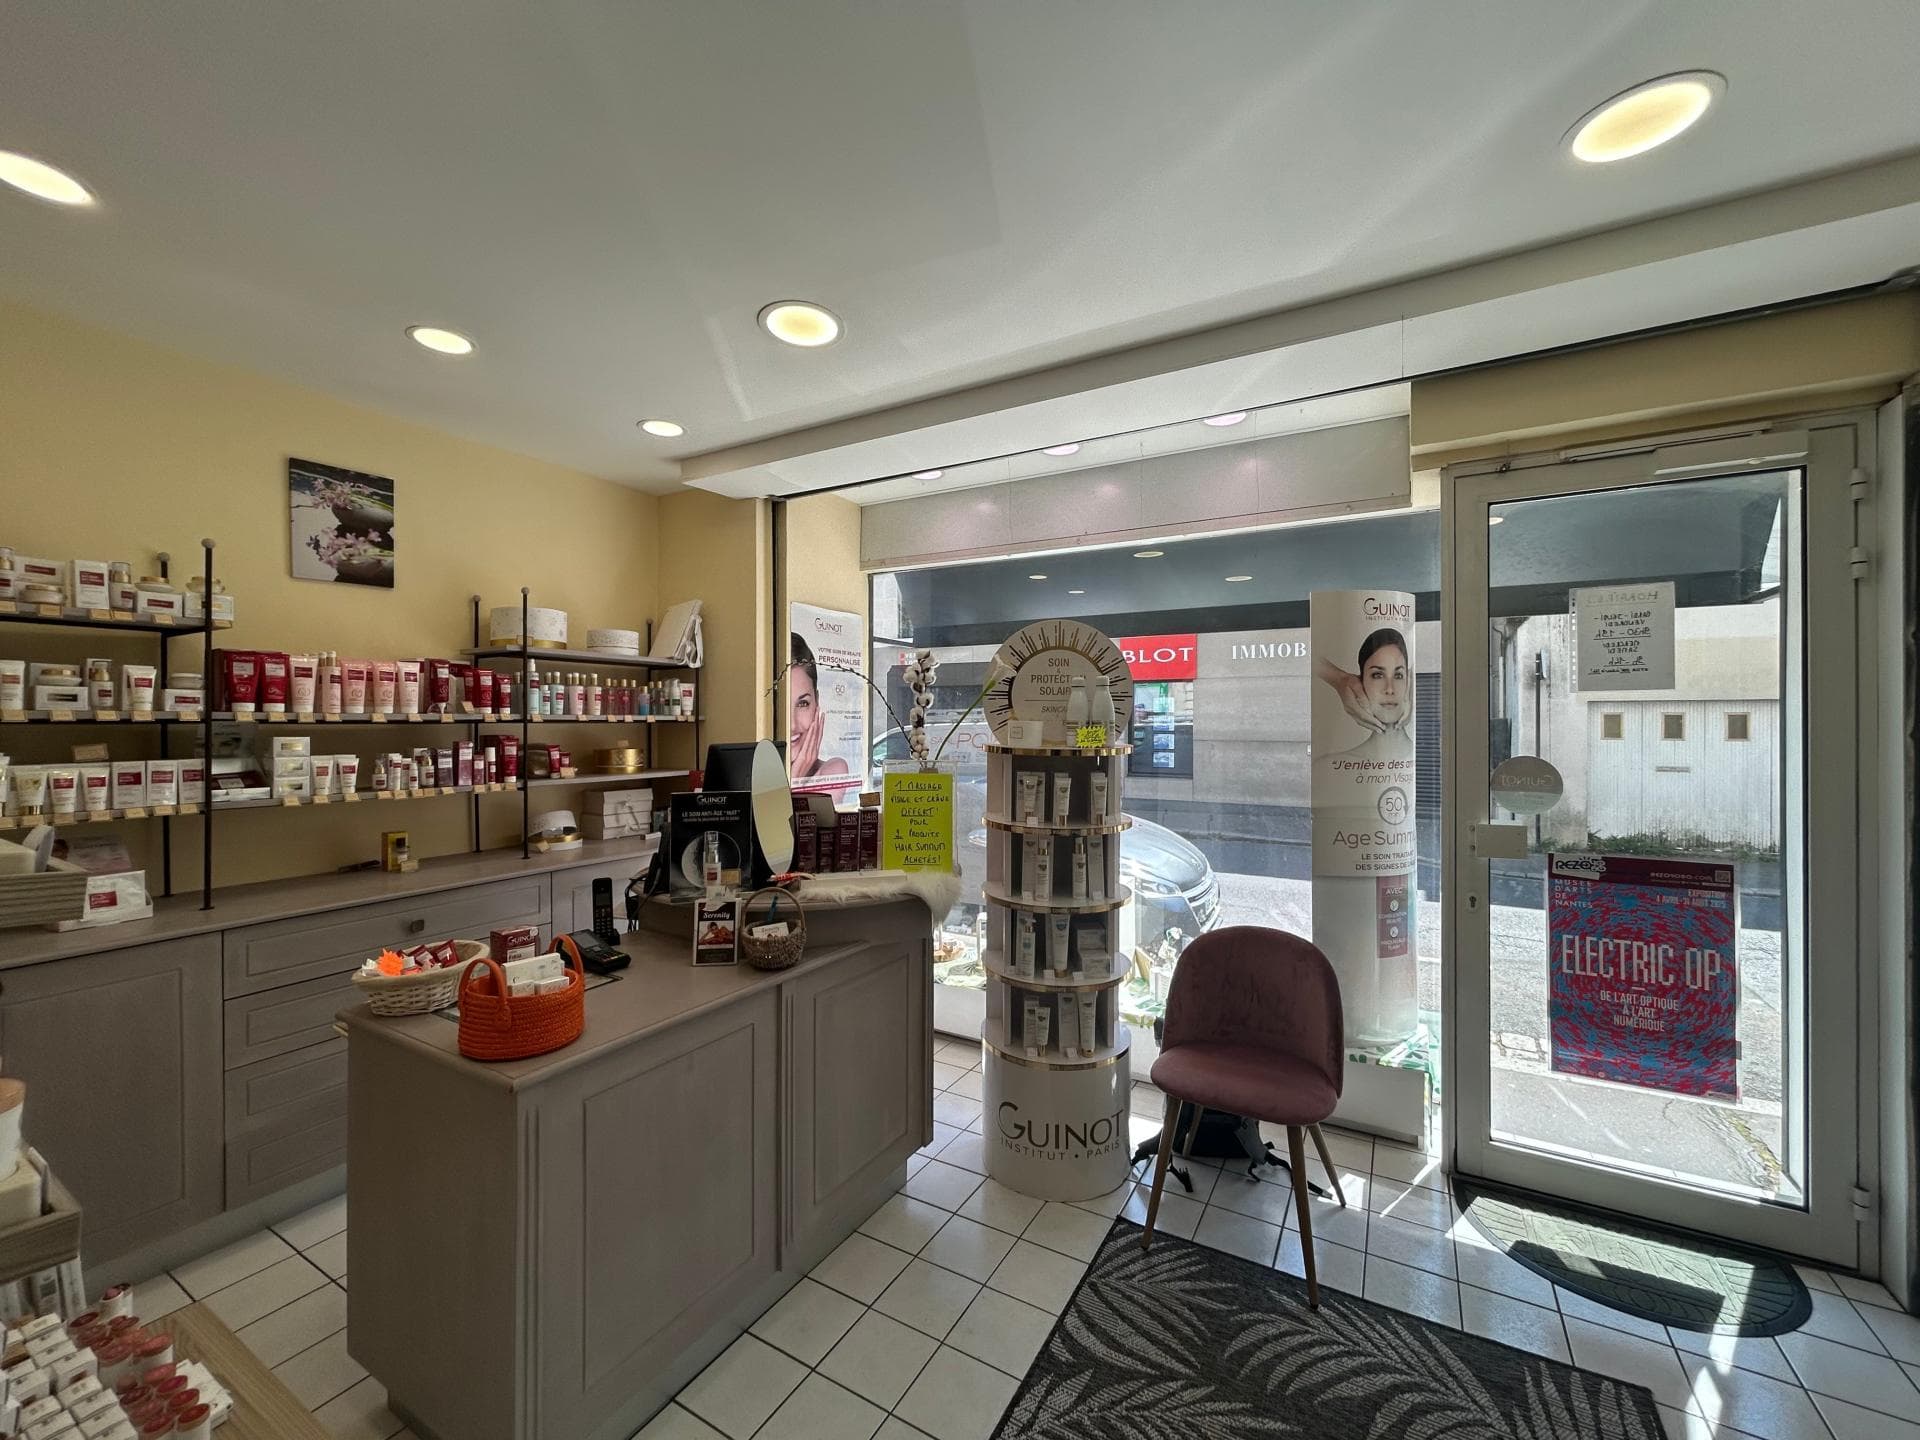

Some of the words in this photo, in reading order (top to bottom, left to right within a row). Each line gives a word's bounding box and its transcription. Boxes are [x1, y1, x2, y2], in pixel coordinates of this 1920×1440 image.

[1363, 597, 1410, 617] GUINOT
[815, 617, 843, 632] GUINOT
[1123, 647, 1194, 663] BLOT
[1232, 642, 1310, 660] IMMOB
[1048, 658, 1070, 667] SOIN
[1031, 674, 1087, 684] PROTECT
[1039, 686, 1072, 696] SOLAIR
[1041, 705, 1068, 713] SKINCA
[1388, 760, 1404, 769] des
[1355, 773, 1364, 784] à
[1367, 775, 1391, 783] mon
[908, 781, 943, 790] MASSAGE
[696, 794, 727, 805] GUINOT
[1385, 797, 1403, 812] 50
[861, 811, 878, 819] HAIR
[1332, 830, 1371, 849] Age
[1374, 830, 1416, 846] Summ
[894, 843, 913, 852] HAIR
[1361, 853, 1371, 861] LE
[1355, 863, 1373, 871] DES
[1373, 862, 1399, 871] SIGNES
[1386, 887, 1404, 895] AVEC
[703, 911, 731, 919] Serenity
[1562, 934, 1674, 986] ELECTRIC
[1686, 946, 1721, 991] OP
[1600, 990, 1611, 1001] DE
[1614, 991, 1637, 1004] L'ART
[1640, 995, 1679, 1011] OPTIQUE
[1632, 1006, 1656, 1018] L'ART
[998, 1101, 1124, 1150] GUINOT
[1001, 1138, 1066, 1161] INSTITUT
[1087, 1141, 1120, 1160] PARIS
